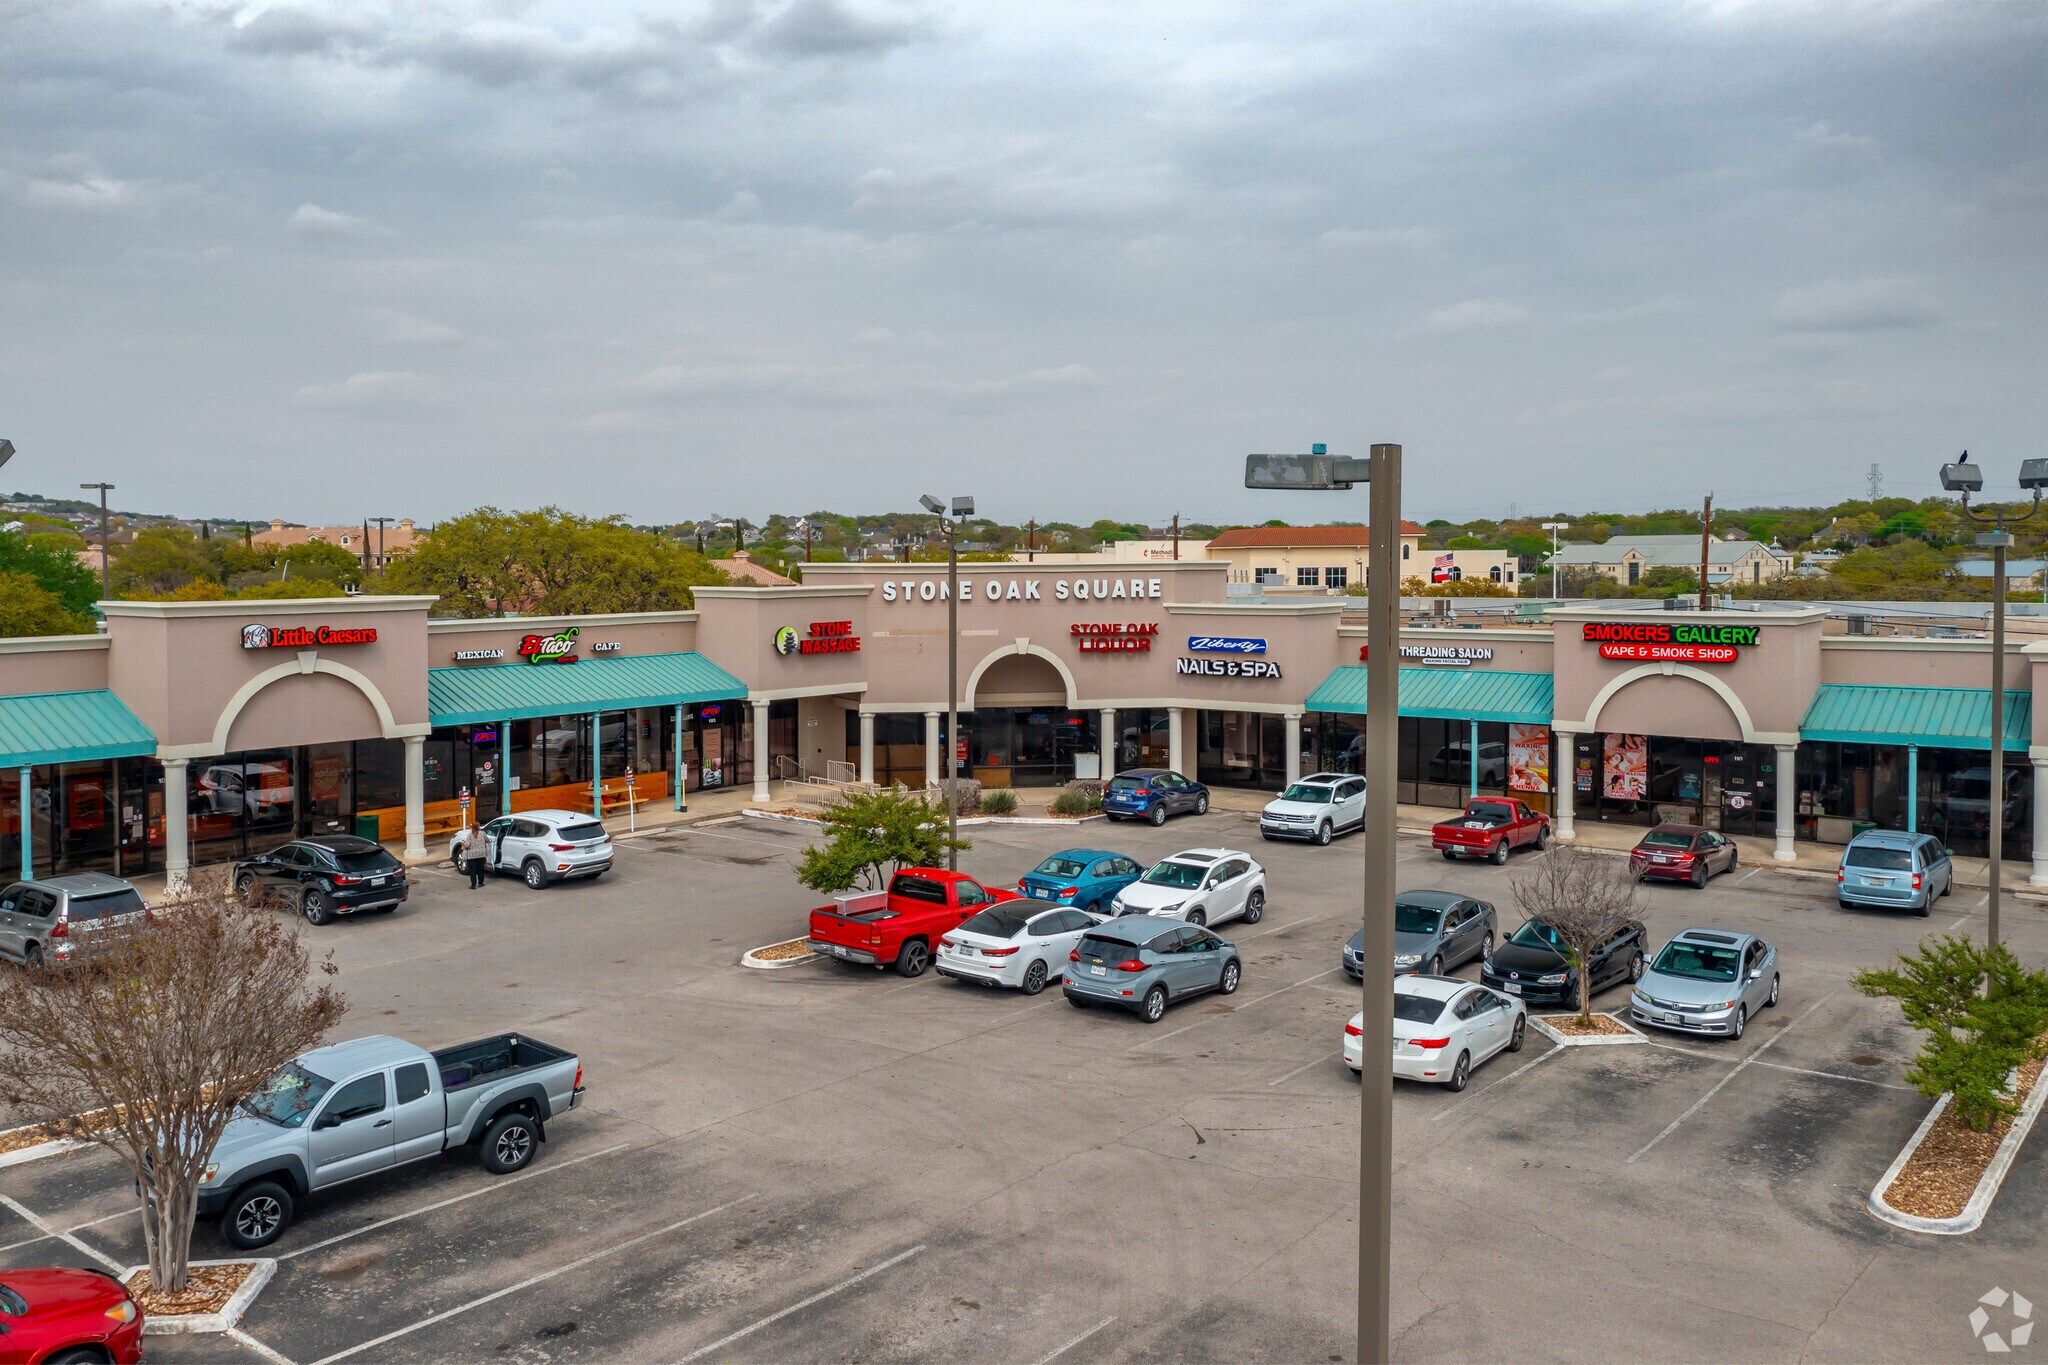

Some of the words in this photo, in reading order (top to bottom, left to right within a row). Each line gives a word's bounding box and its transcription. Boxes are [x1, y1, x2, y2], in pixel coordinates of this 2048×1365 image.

[883, 580, 972, 601] STONE
[986, 580, 1041, 600] OAK
[1056, 578, 1162, 600] SQUARE
[810, 621, 852, 637] STONE
[1070, 623, 1122, 637] STONE
[1126, 623, 1159, 636] OAK
[1583, 624, 1670, 642] SMOKERS
[1676, 627, 1758, 644] GALLERY
[271, 627, 315, 648] Little
[317, 626, 377, 645] Caesars
[520, 635, 543, 656] El
[541, 637, 576, 654] Taco
[595, 642, 621, 652] CAFE
[800, 637, 861, 655] MASSAGE
[1079, 638, 1151, 653] LIQUOR
[1191, 638, 1266, 653] Liberty
[1400, 646, 1456, 659] THREADING
[1458, 648, 1492, 660] SALON
[1603, 646, 1635, 657] VAPE
[1638, 647, 1648, 657] &
[1651, 647, 1695, 658] SMOKE
[1698, 648, 1733, 659] SHOP
[456, 649, 504, 661] MEXICAN
[1176, 658, 1224, 675] NAILS
[1227, 662, 1239, 676] &
[1241, 661, 1280, 678] SPA
[703, 707, 718, 715] OPEN
[475, 733, 495, 741] OPEN
[1515, 742, 1543, 750] WAXING
